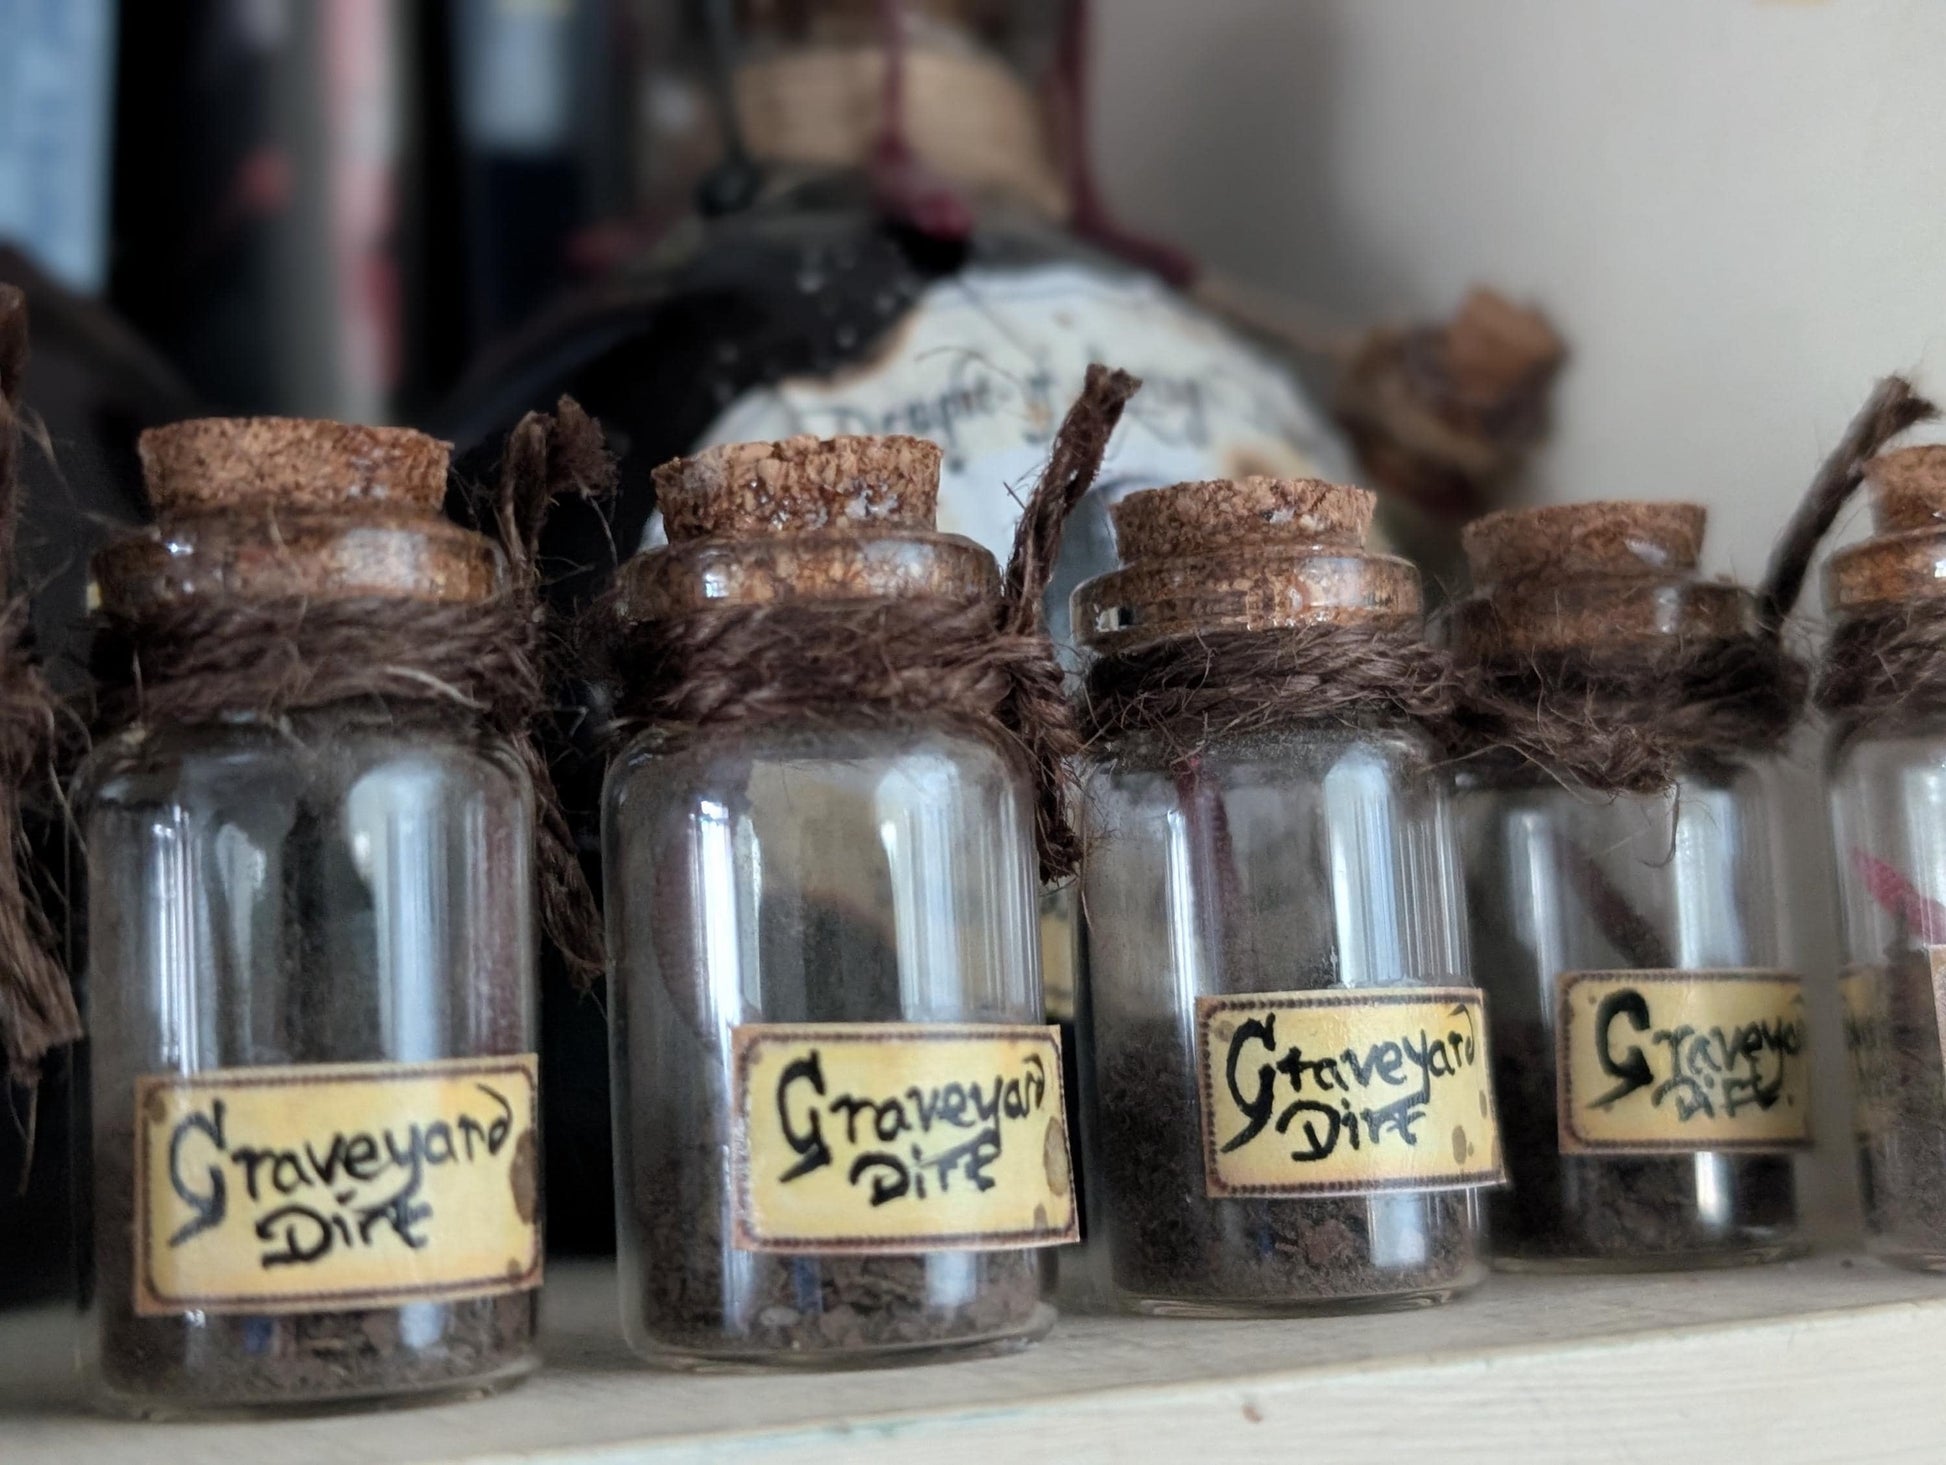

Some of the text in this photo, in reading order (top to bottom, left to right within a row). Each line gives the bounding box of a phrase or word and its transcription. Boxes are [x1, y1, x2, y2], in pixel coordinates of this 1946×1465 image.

[1219, 1004, 1475, 1152] Graveyard
[169, 1083, 513, 1247] Graveyard
[1275, 1097, 1427, 1161] Dirt
[849, 1132, 1002, 1206] Dirt
[255, 1193, 433, 1269] Dirt
